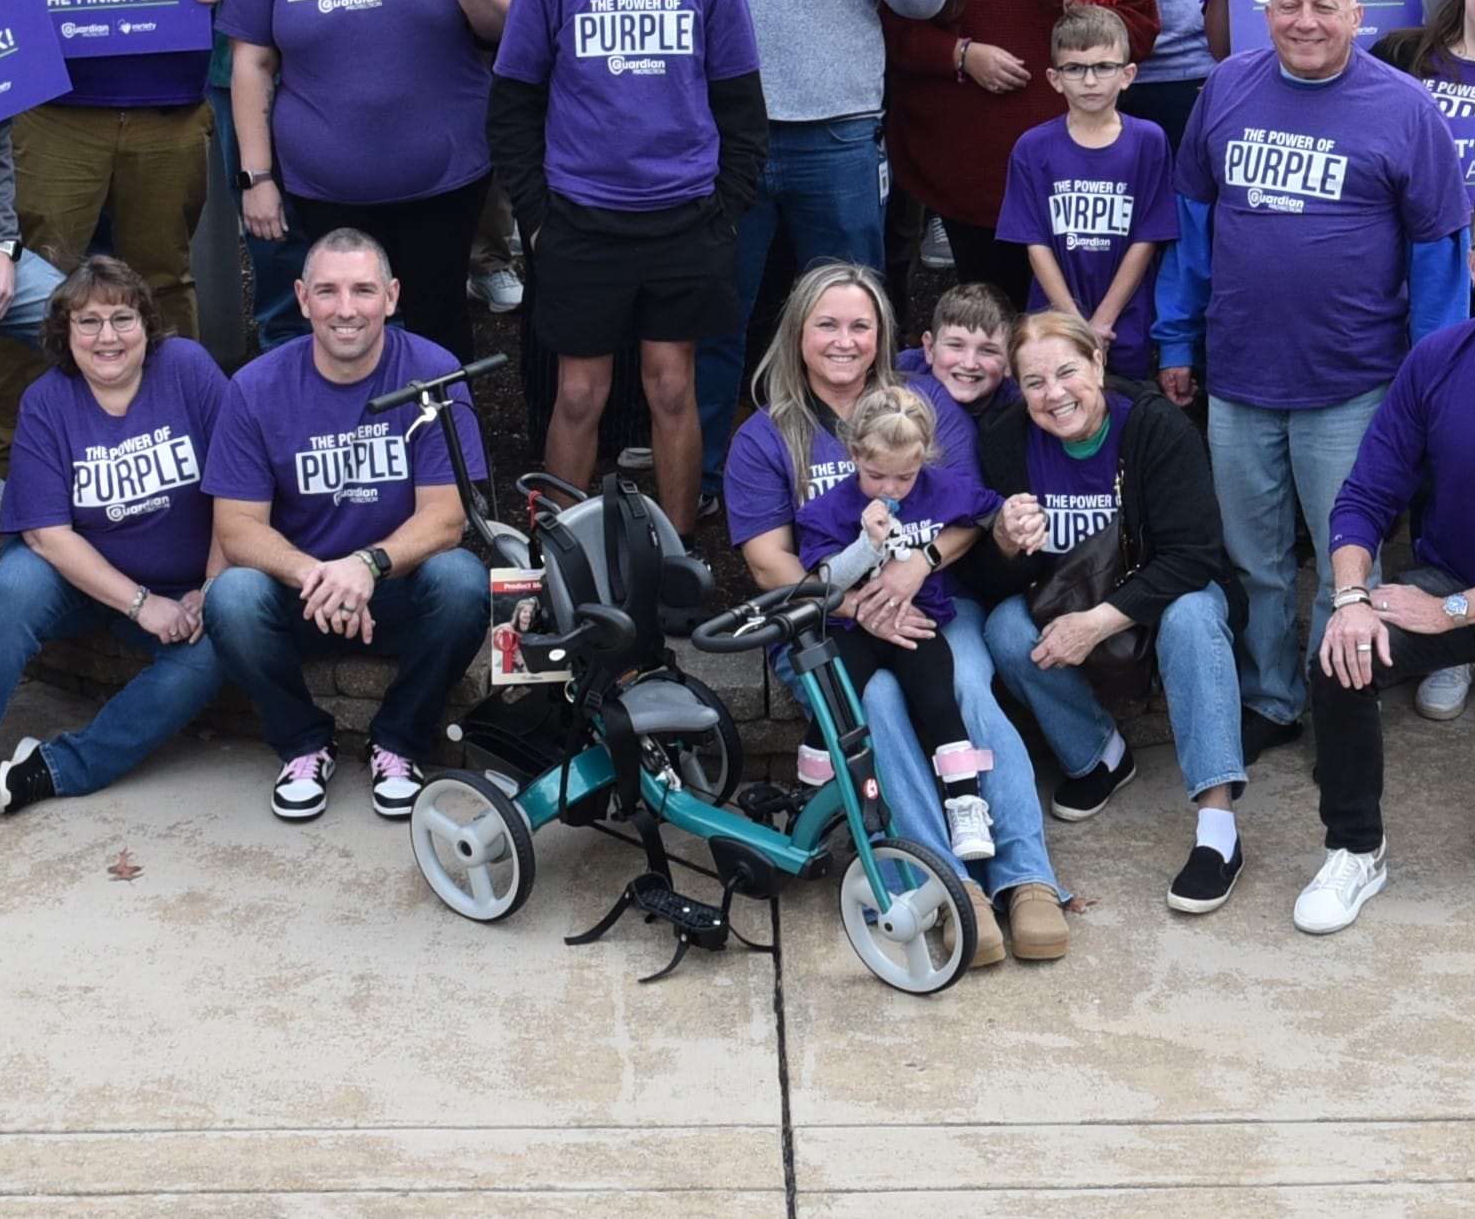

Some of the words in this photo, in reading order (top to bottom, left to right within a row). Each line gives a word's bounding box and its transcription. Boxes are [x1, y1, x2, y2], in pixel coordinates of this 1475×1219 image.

[580, 13, 691, 54] PURPLE
[608, 55, 666, 74] Guardian
[1243, 127, 1265, 144] THE
[1267, 130, 1314, 150] POWER
[1316, 137, 1335, 153] OF
[1228, 142, 1343, 198] PURPLE
[1053, 180, 1072, 193] THE
[1074, 180, 1114, 193] POWER
[1247, 188, 1304, 212] Guardian
[1066, 233, 1111, 251] Guardian
[86, 446, 109, 462] THE
[109, 436, 153, 460] POWER
[153, 425, 172, 443] OF
[309, 435, 336, 450] THE
[372, 423, 389, 437] OF
[76, 439, 195, 503] PURPLE
[809, 462, 837, 478] THE
[1044, 493, 1069, 508] THE
[1069, 494, 1113, 508] POWER
